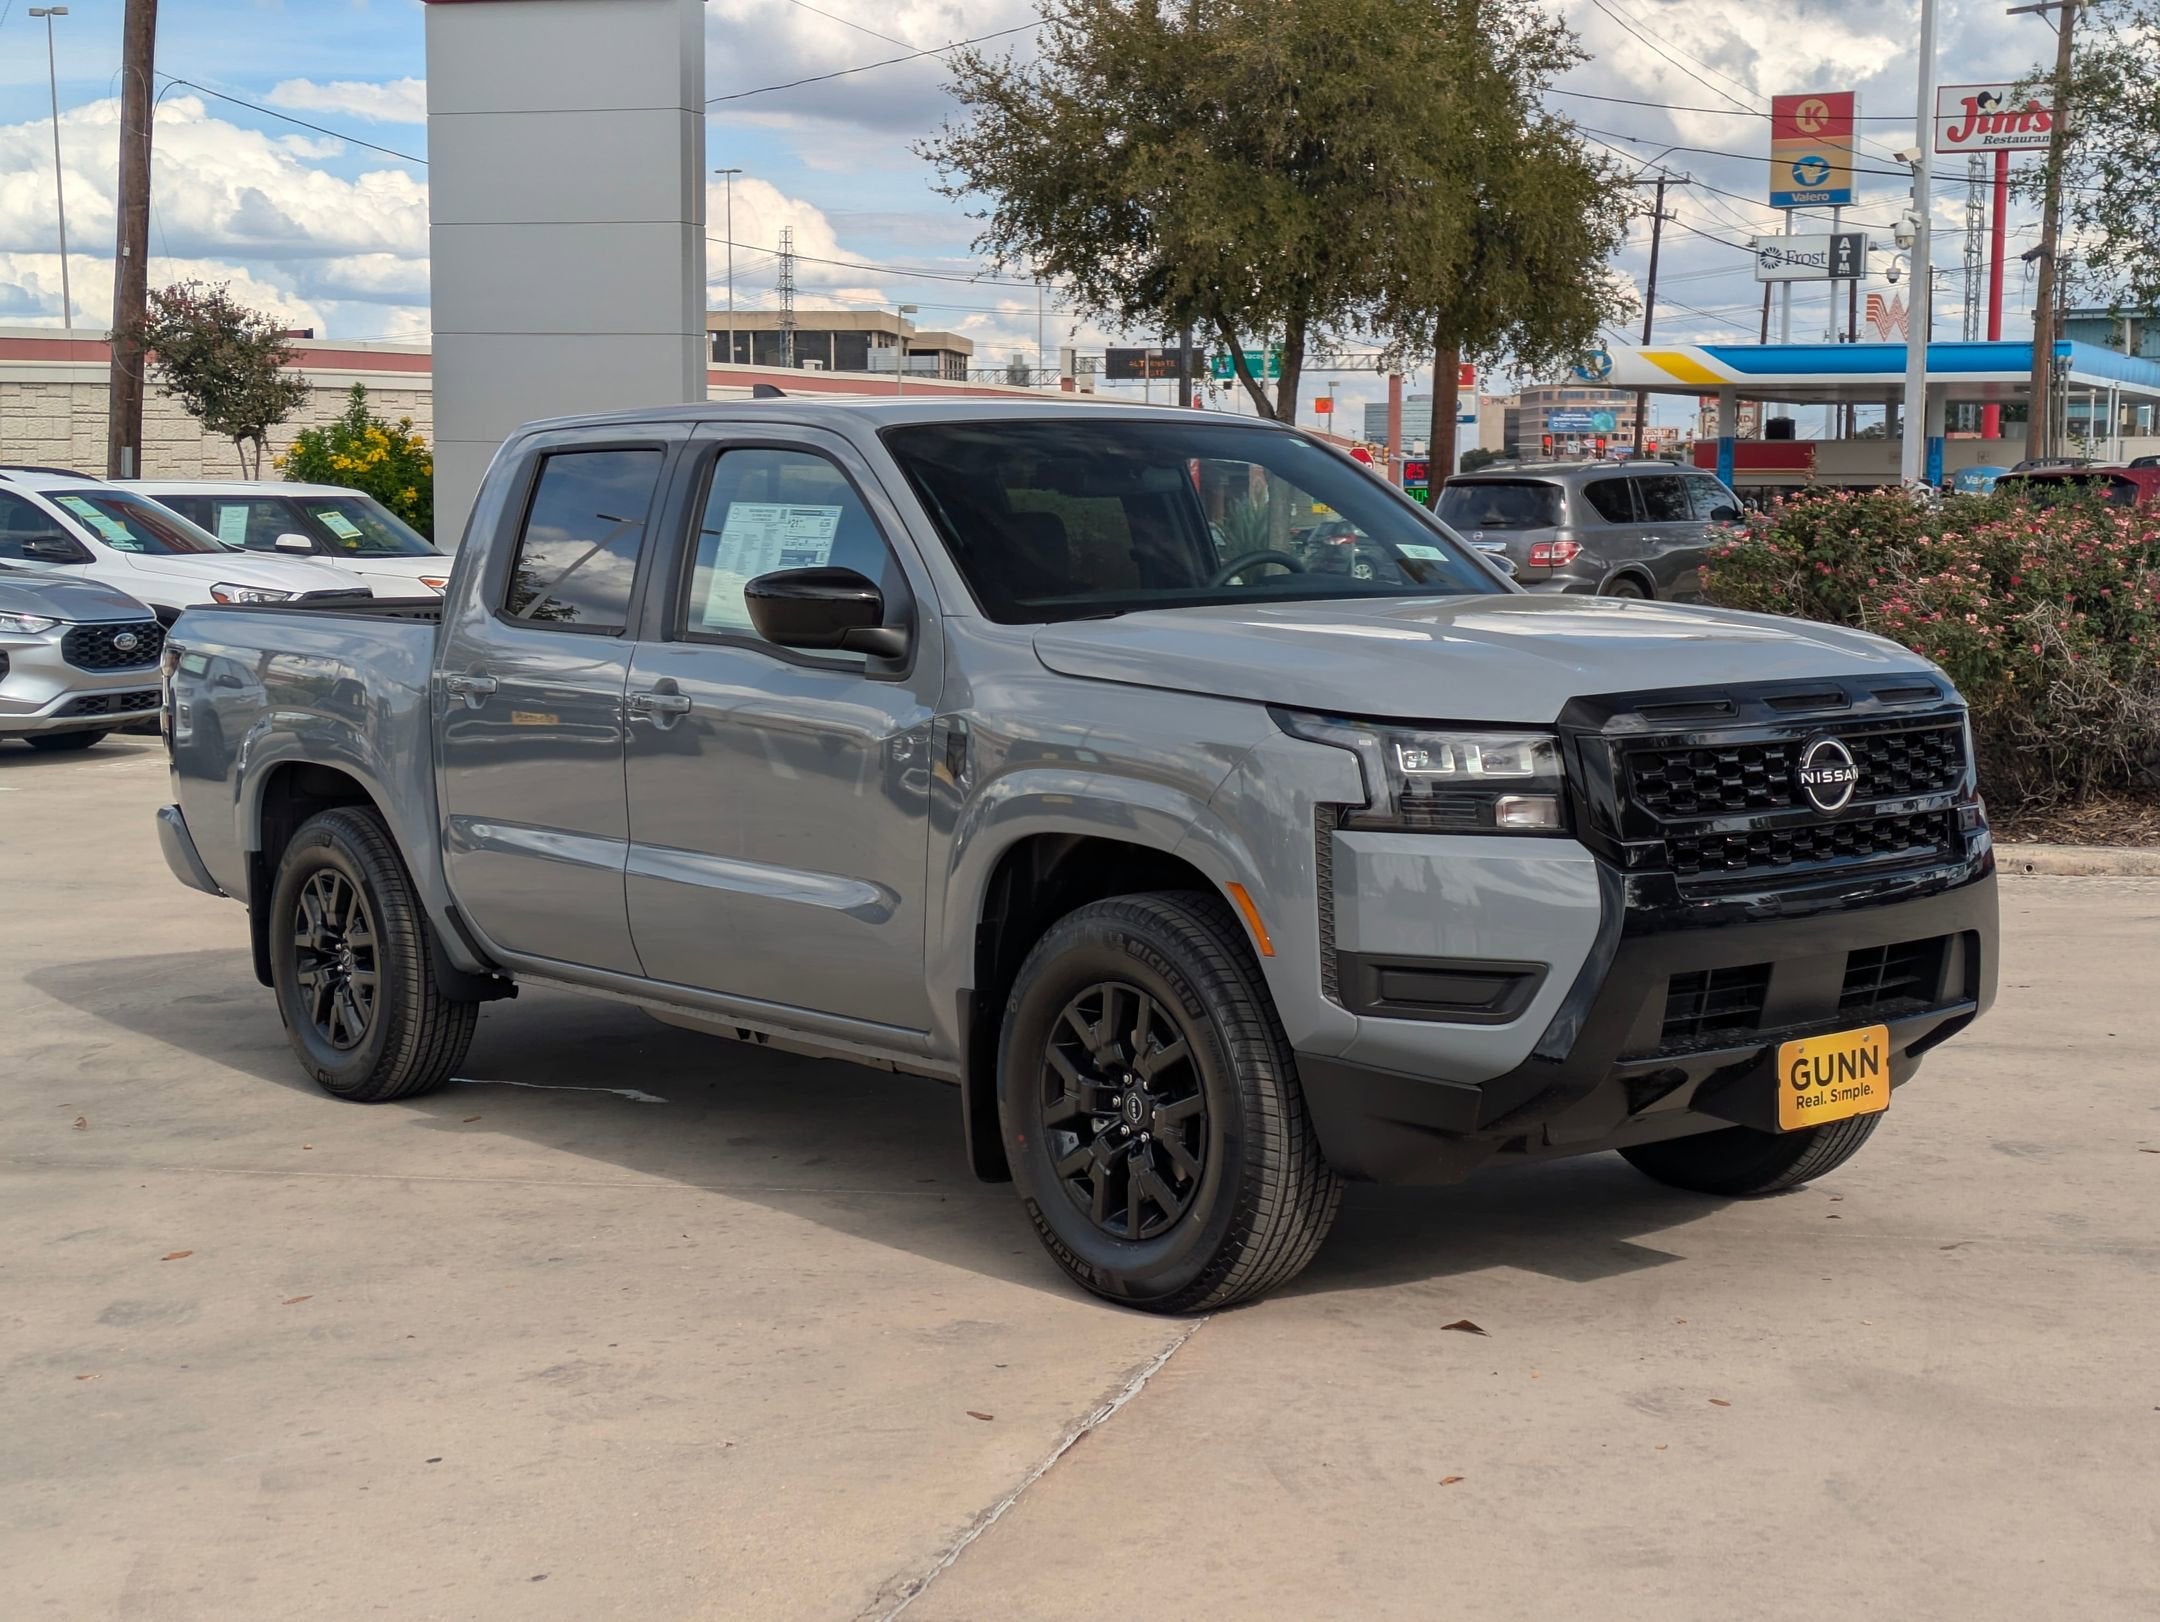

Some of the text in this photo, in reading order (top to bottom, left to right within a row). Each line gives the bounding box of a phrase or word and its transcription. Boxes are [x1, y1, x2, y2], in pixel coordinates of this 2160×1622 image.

[1947, 97, 2052, 142] Jim's
[1982, 135, 2050, 145] Restauran
[1792, 193, 1829, 202] Valero
[1786, 250, 1827, 265] Frost
[1838, 237, 1851, 274] ATM
[1801, 768, 1858, 784] NISSAN
[1128, 940, 1201, 1016] MICHELIN
[1790, 1045, 1878, 1091] GUNN
[1796, 1091, 1827, 1110] Real.
[1026, 1201, 1092, 1278] MICHELIN
